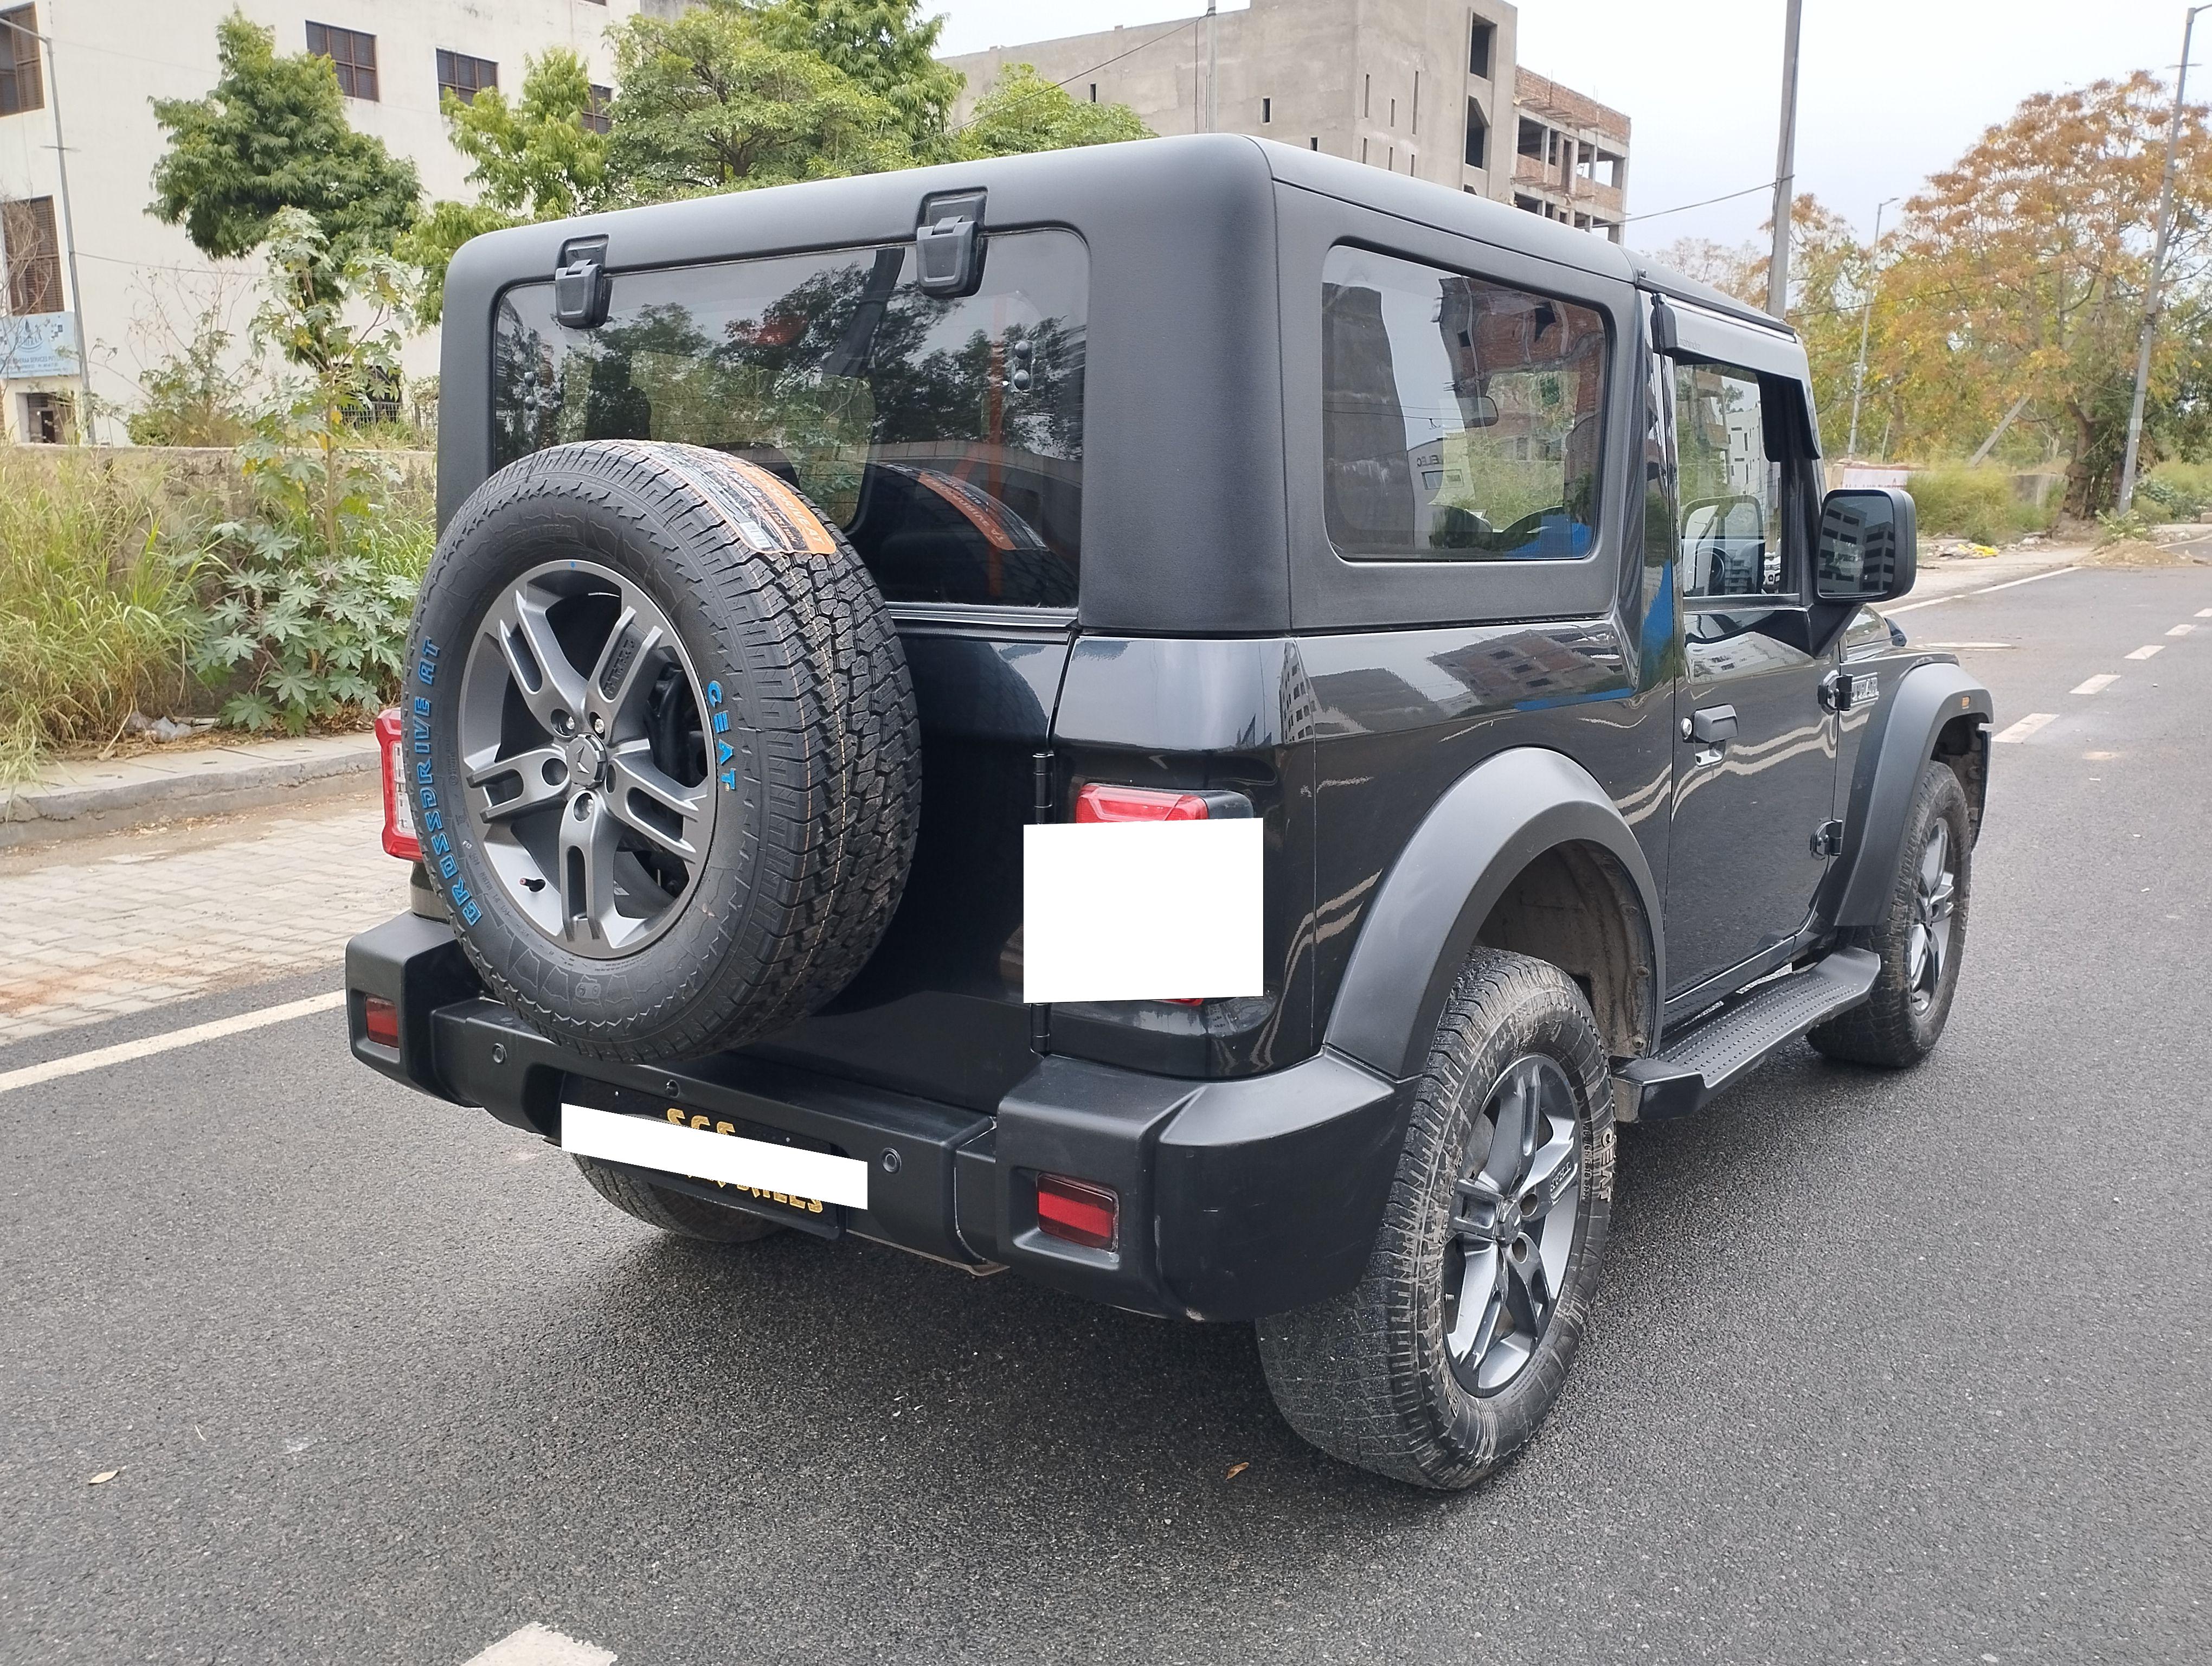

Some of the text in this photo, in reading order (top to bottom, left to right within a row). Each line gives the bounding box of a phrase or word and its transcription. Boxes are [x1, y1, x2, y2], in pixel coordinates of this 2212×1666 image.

[412, 636, 483, 926] CROSSDRIVE AT
[707, 680, 737, 792] CEAT
[1600, 1128, 1615, 1202] CEAT
